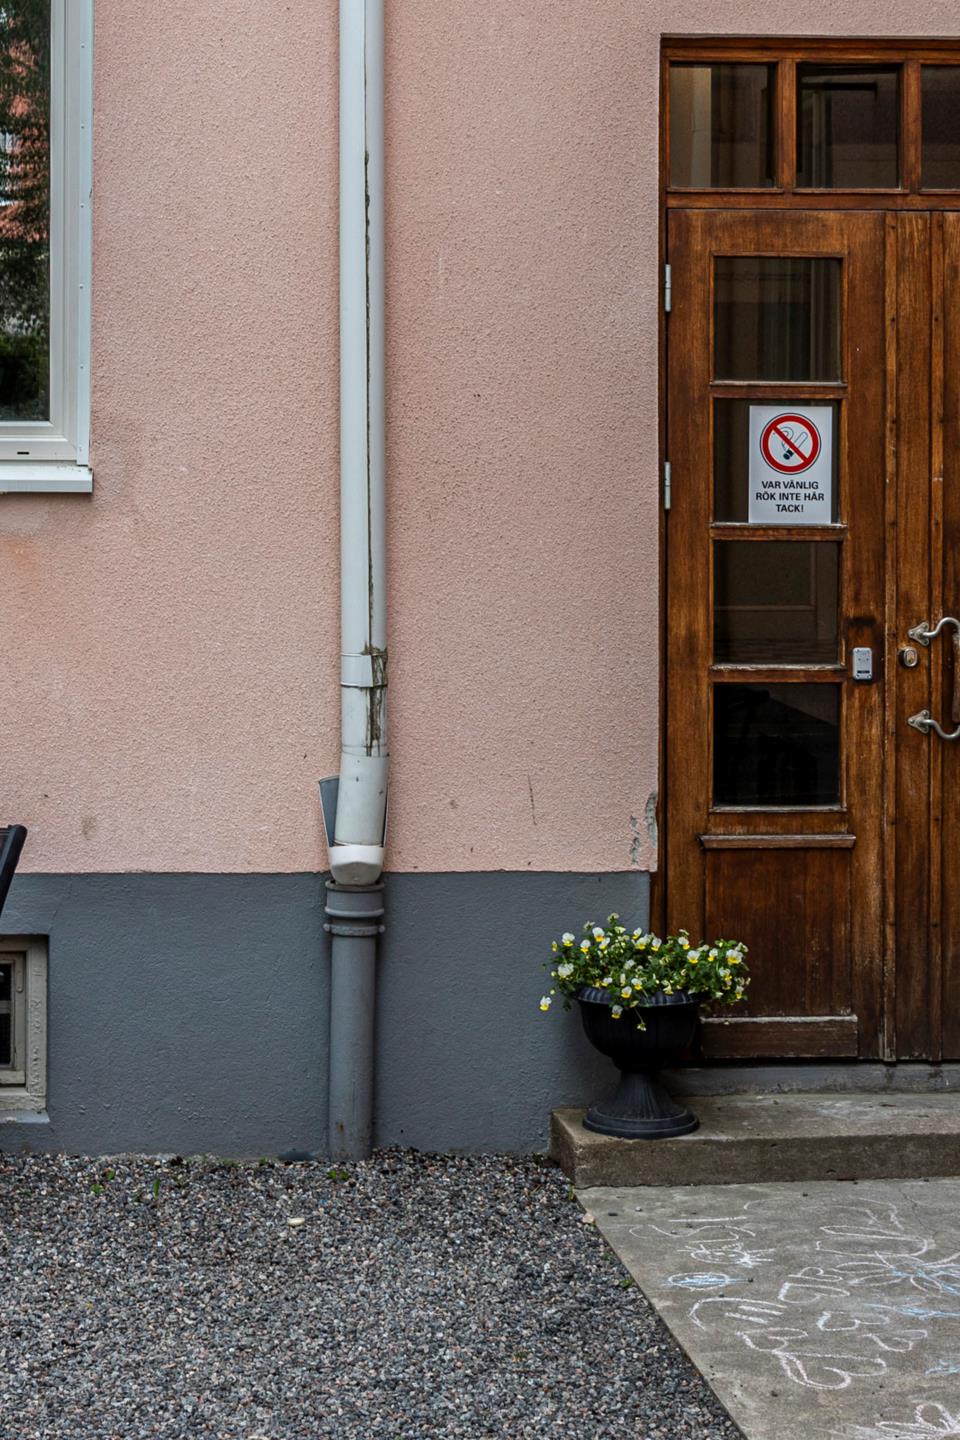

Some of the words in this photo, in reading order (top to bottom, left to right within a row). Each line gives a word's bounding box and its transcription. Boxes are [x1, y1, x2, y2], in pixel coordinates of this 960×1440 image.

[761, 481, 781, 489] VAR
[783, 480, 819, 489] VÄNLIG
[755, 491, 776, 501] RÖK
[779, 492, 801, 501] INTE
[804, 491, 825, 501] HÄR
[776, 504, 804, 513] TACK!
